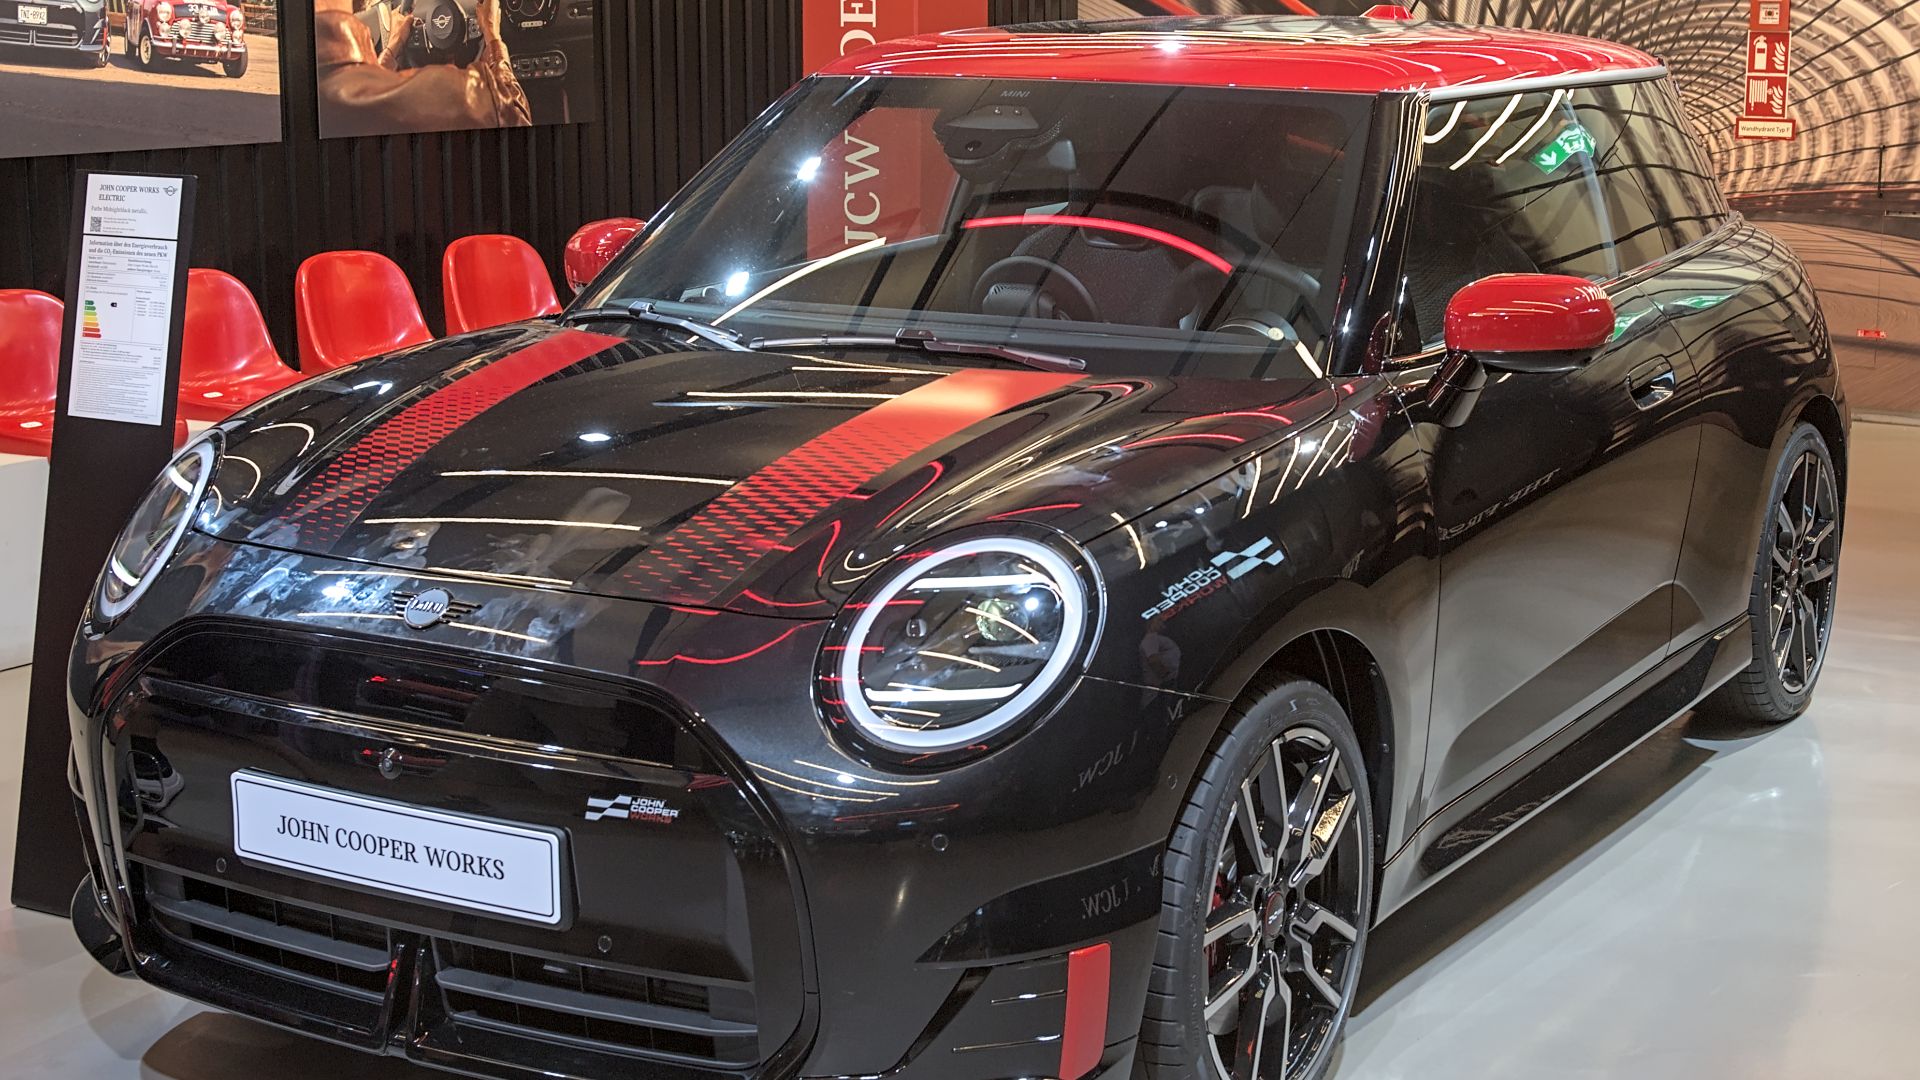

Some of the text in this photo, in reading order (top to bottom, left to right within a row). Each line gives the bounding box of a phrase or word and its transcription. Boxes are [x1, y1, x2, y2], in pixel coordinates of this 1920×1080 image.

[1000, 90, 1031, 98] MINI
[99, 184, 160, 194] JOHN COOPER WORKS
[844, 129, 881, 246] JCW
[98, 193, 126, 202] ELECTRIC
[631, 797, 666, 808] JOHN
[630, 805, 679, 817] COOPER
[630, 811, 673, 824] WORKS
[277, 815, 505, 880] JOHN COOPER WORKS
